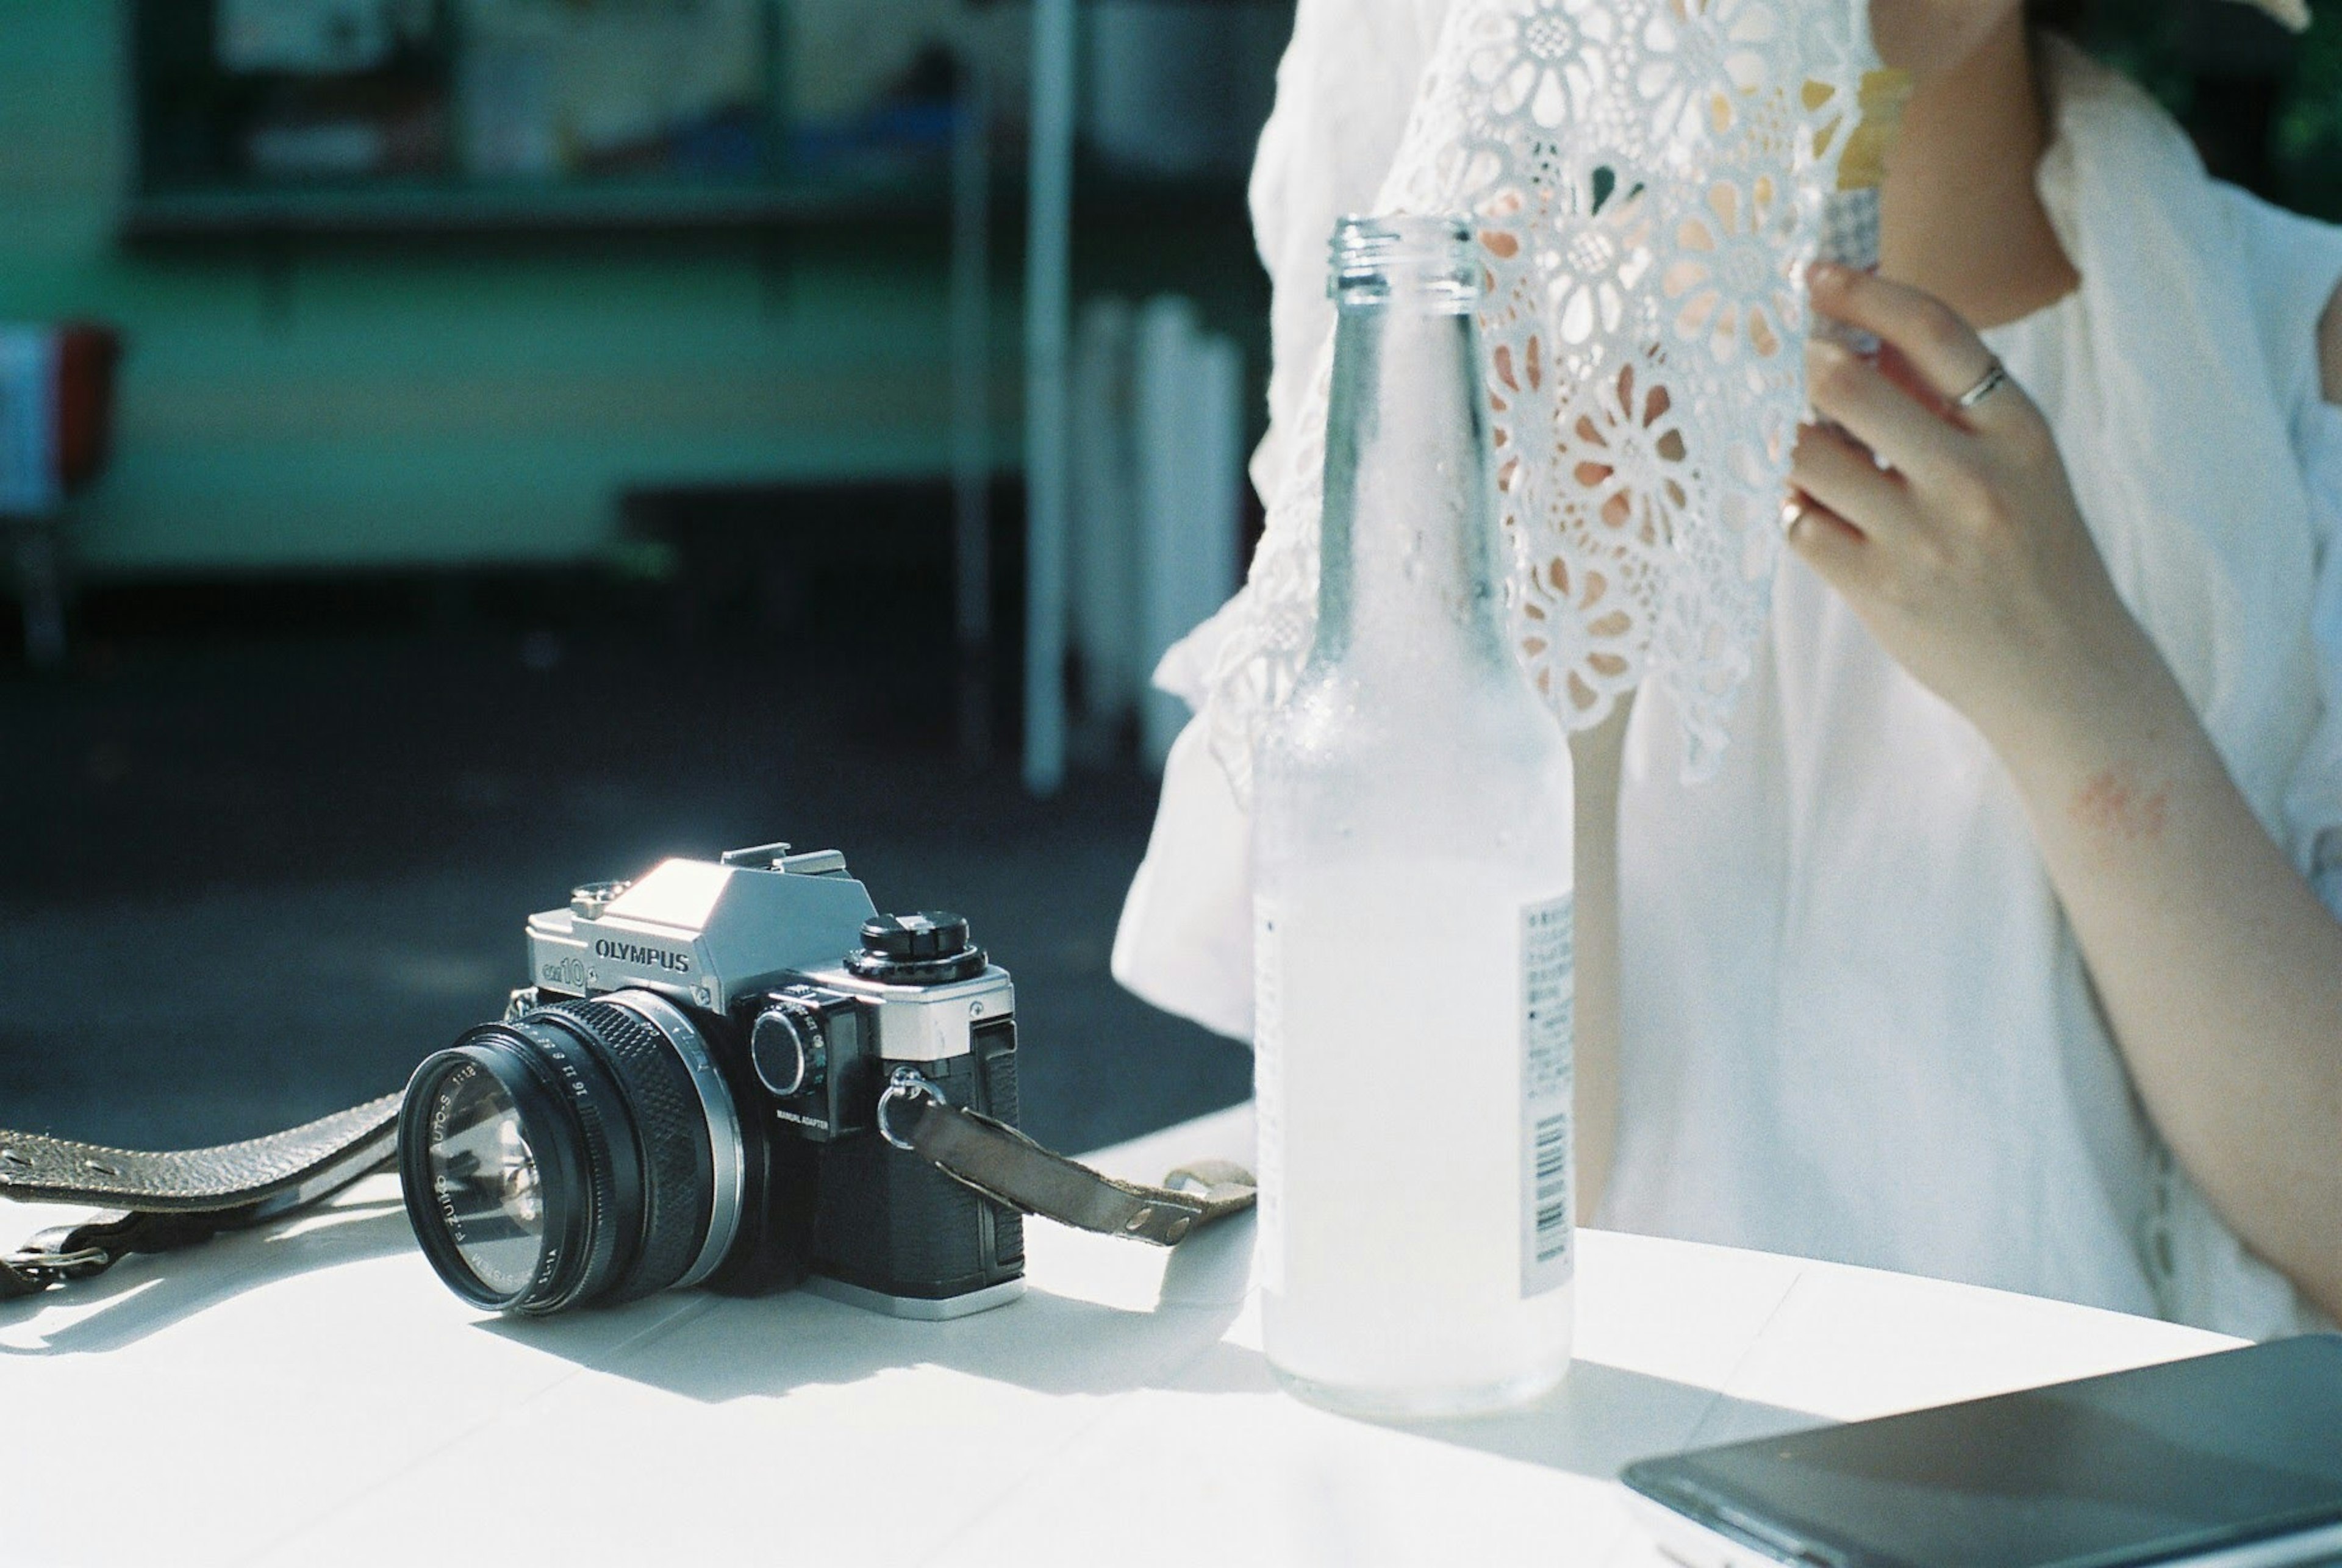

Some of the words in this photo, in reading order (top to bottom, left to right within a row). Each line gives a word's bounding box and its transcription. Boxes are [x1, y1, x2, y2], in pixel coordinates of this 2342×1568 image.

[595, 939, 689, 973] OLYMPUS
[562, 1065, 578, 1078] 11
[572, 1081, 588, 1096] 16
[432, 1095, 451, 1152] AUTO-S
[776, 1109, 801, 1123] MANUAL
[801, 1115, 829, 1130] ADAPTER
[434, 1175, 467, 1242] F.ZUIKO
